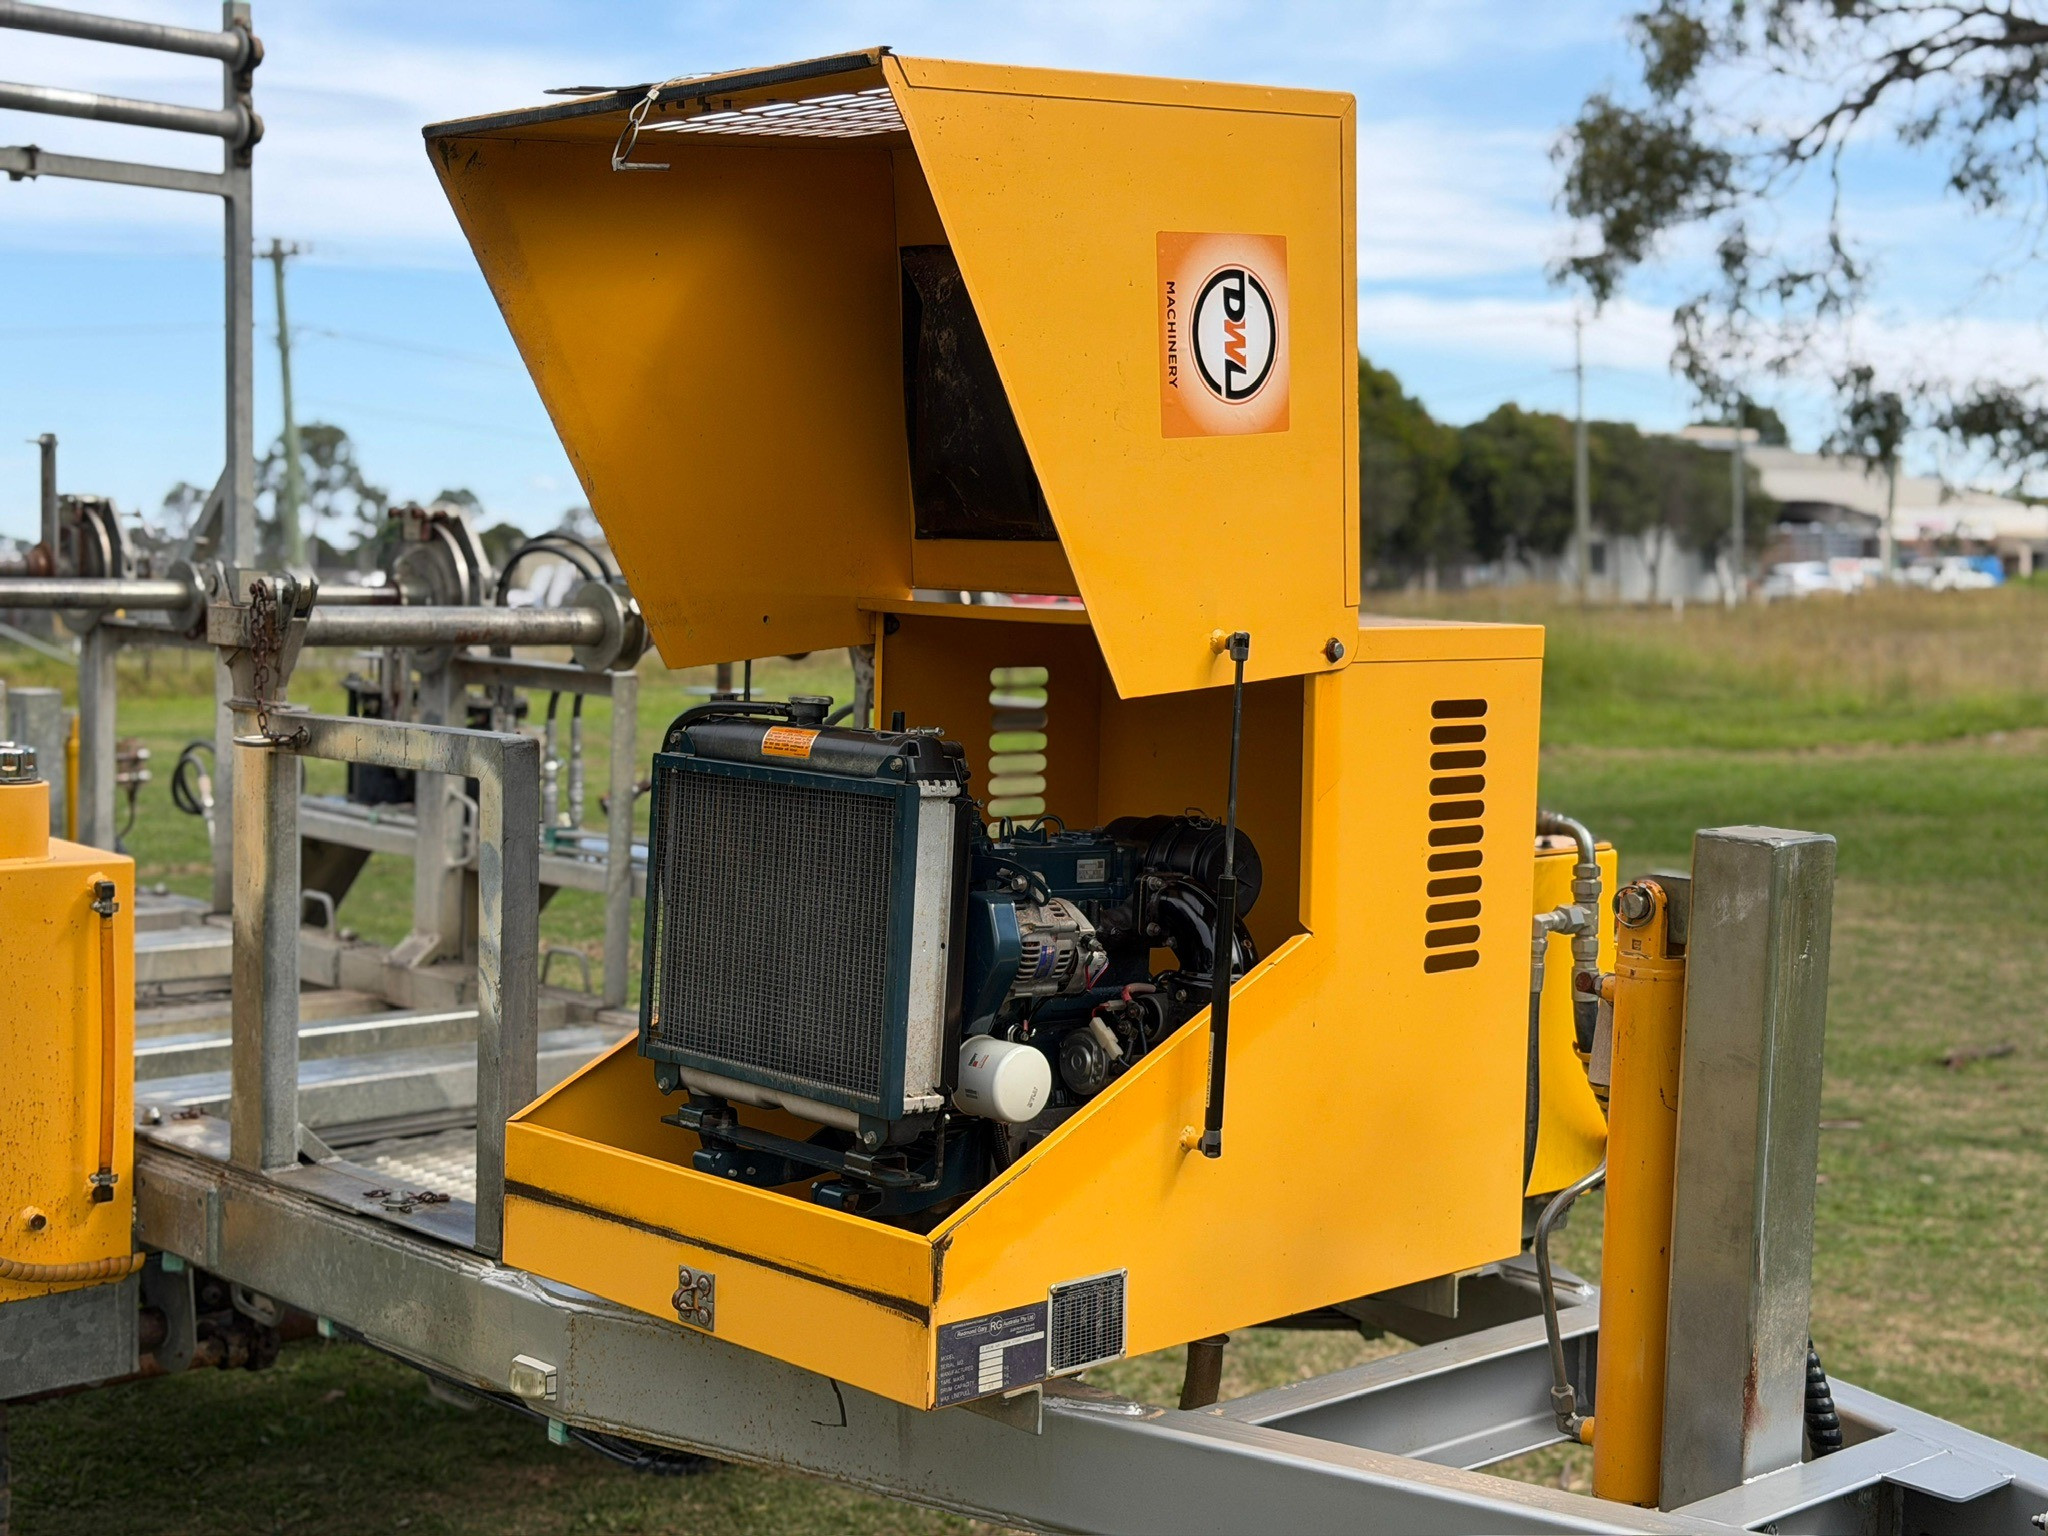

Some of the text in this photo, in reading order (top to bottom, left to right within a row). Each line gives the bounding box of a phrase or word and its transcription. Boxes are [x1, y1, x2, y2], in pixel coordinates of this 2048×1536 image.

[1166, 281, 1178, 389] MACHINERY
[1223, 271, 1247, 399] DWL
[956, 1328, 977, 1337] Redmond
[977, 1325, 988, 1334] Gary
[990, 1320, 1003, 1331] RG
[1003, 1318, 1020, 1326] Australia
